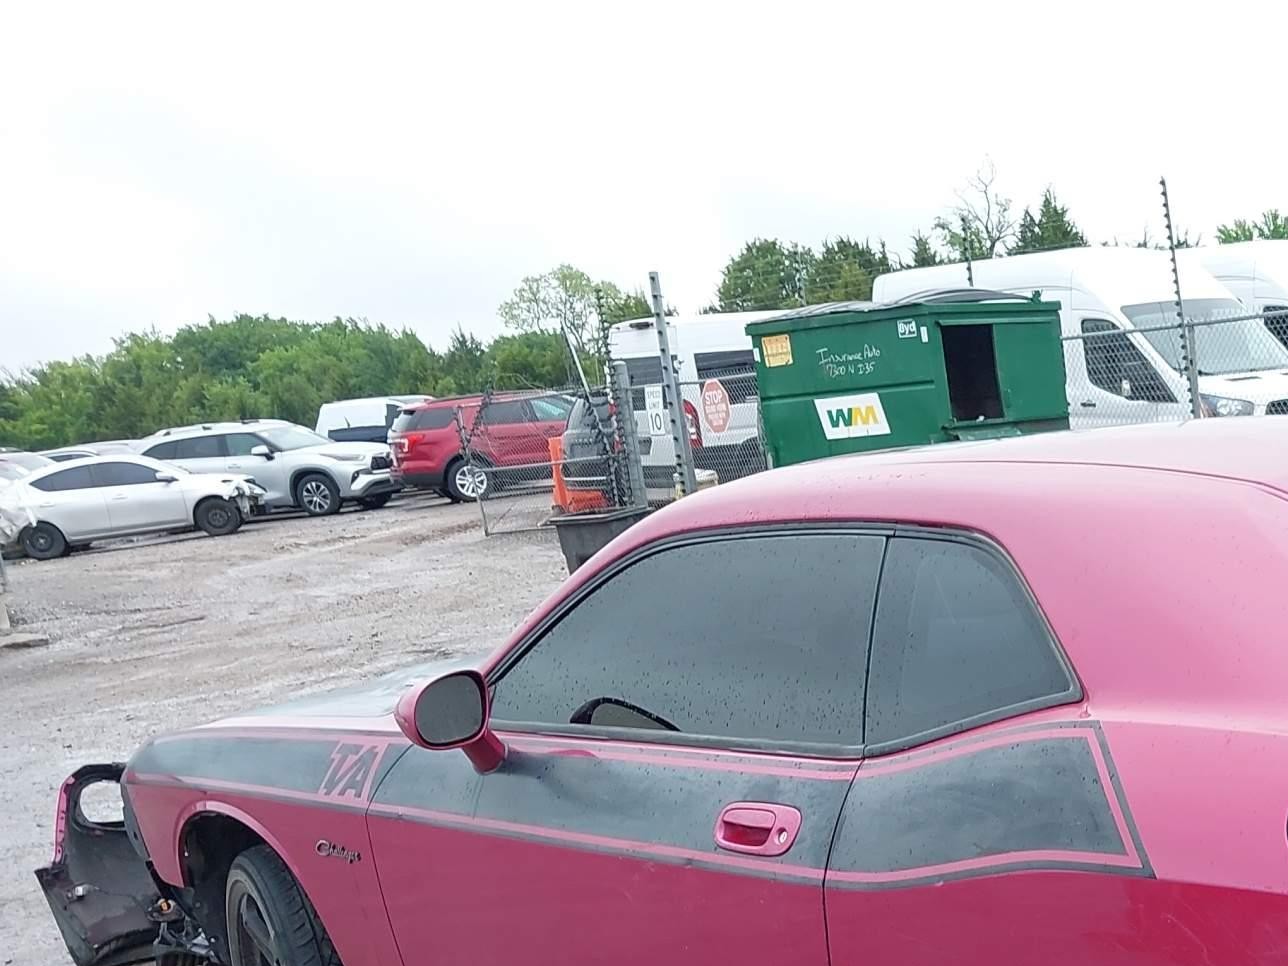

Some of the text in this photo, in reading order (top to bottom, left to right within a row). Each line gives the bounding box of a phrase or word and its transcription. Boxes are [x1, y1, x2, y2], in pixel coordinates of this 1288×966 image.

[816, 343, 881, 365] Insurance Auto
[848, 363, 855, 374] N
[705, 389, 723, 405] STOP
[650, 412, 662, 432] 10
[826, 405, 880, 428] WM
